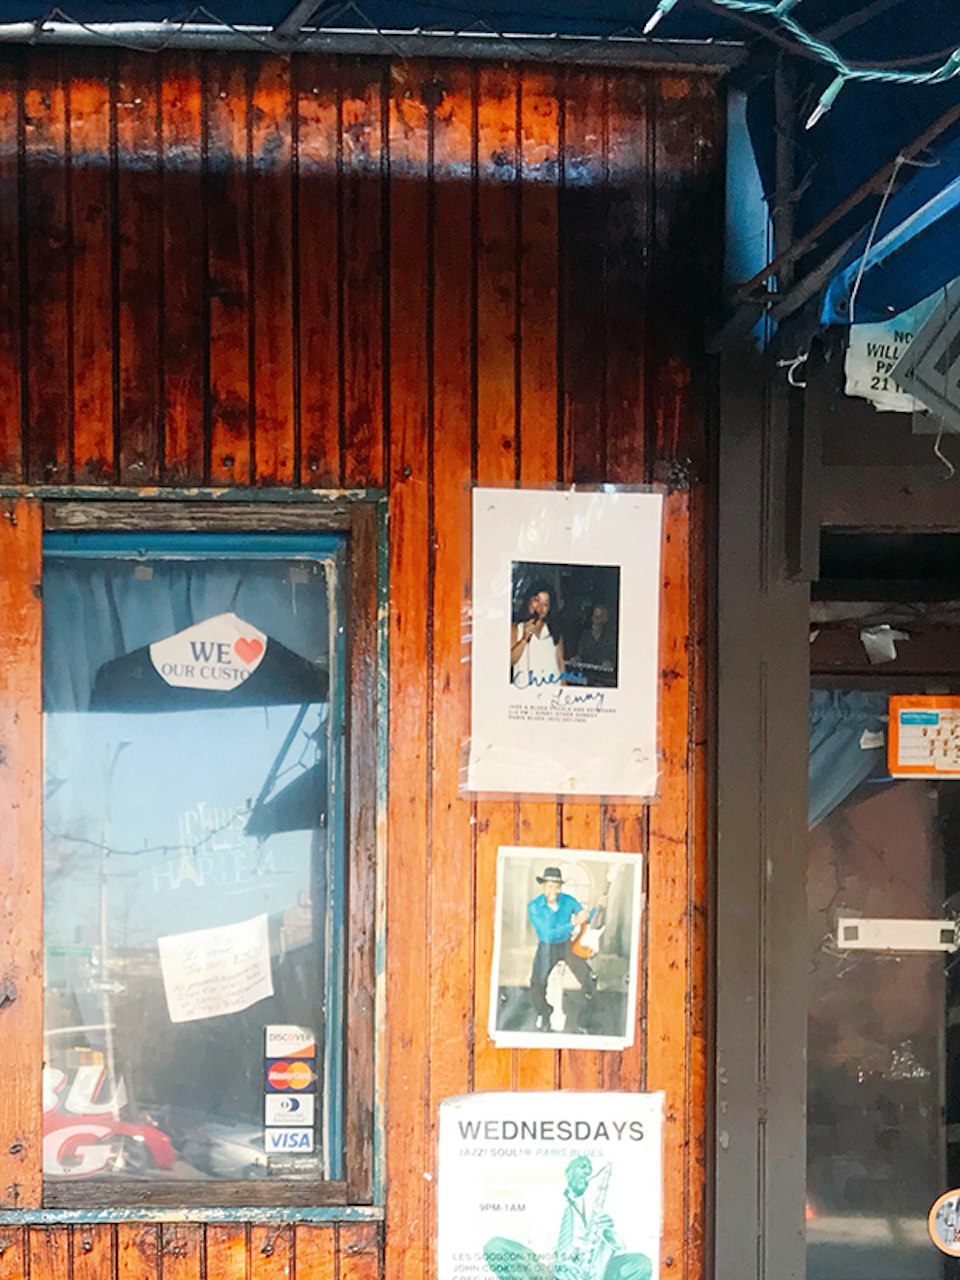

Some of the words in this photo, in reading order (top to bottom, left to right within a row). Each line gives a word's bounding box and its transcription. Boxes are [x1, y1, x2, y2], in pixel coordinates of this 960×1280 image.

[870, 376, 889, 391] 21
[189, 640, 232, 666] WE
[161, 663, 196, 679] OUR
[458, 1120, 645, 1142] WEDNESDAYS
[270, 1132, 311, 1148] VISA
[535, 1148, 567, 1158] PARIS
[451, 1252, 472, 1262] LES
[452, 1264, 480, 1273] JOHN
